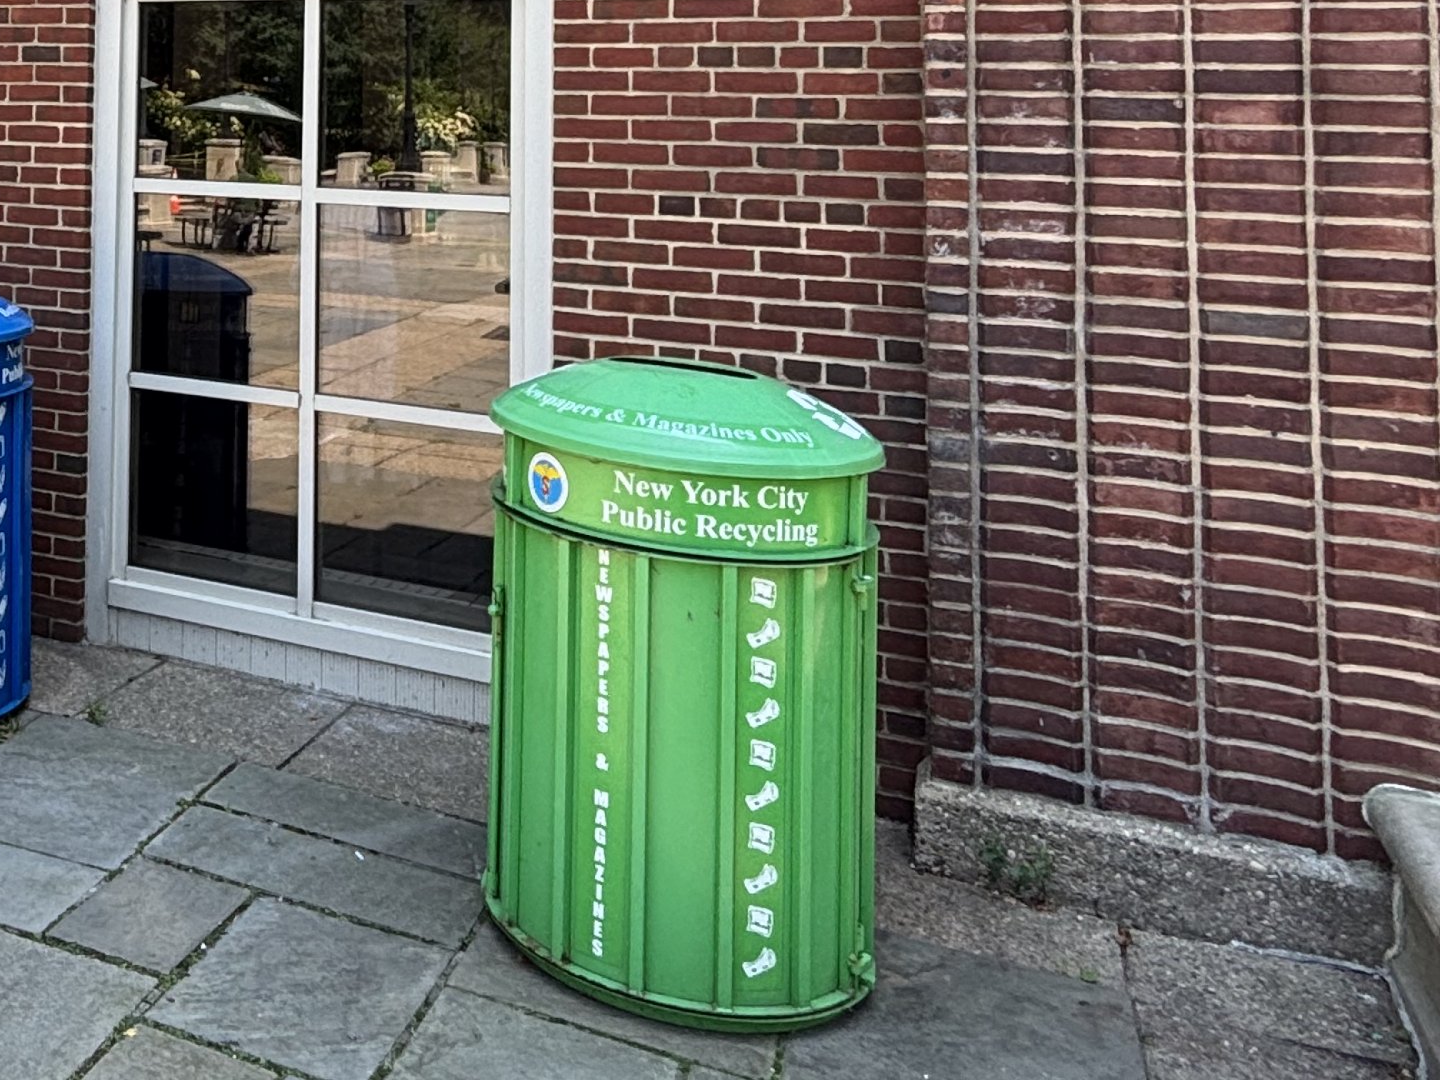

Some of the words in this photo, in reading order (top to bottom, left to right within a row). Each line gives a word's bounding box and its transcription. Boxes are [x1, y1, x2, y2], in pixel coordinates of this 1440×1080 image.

[605, 408, 626, 423] &
[632, 412, 758, 441] Magazines
[760, 427, 814, 448] Only
[613, 470, 674, 501] New
[681, 480, 750, 509] York
[757, 485, 809, 515] City
[601, 499, 686, 536] Public
[695, 514, 819, 548] Recycling
[595, 550, 613, 733] NEWSPAPERS
[595, 752, 609, 771] &
[591, 788, 609, 957] MAGAZINES
